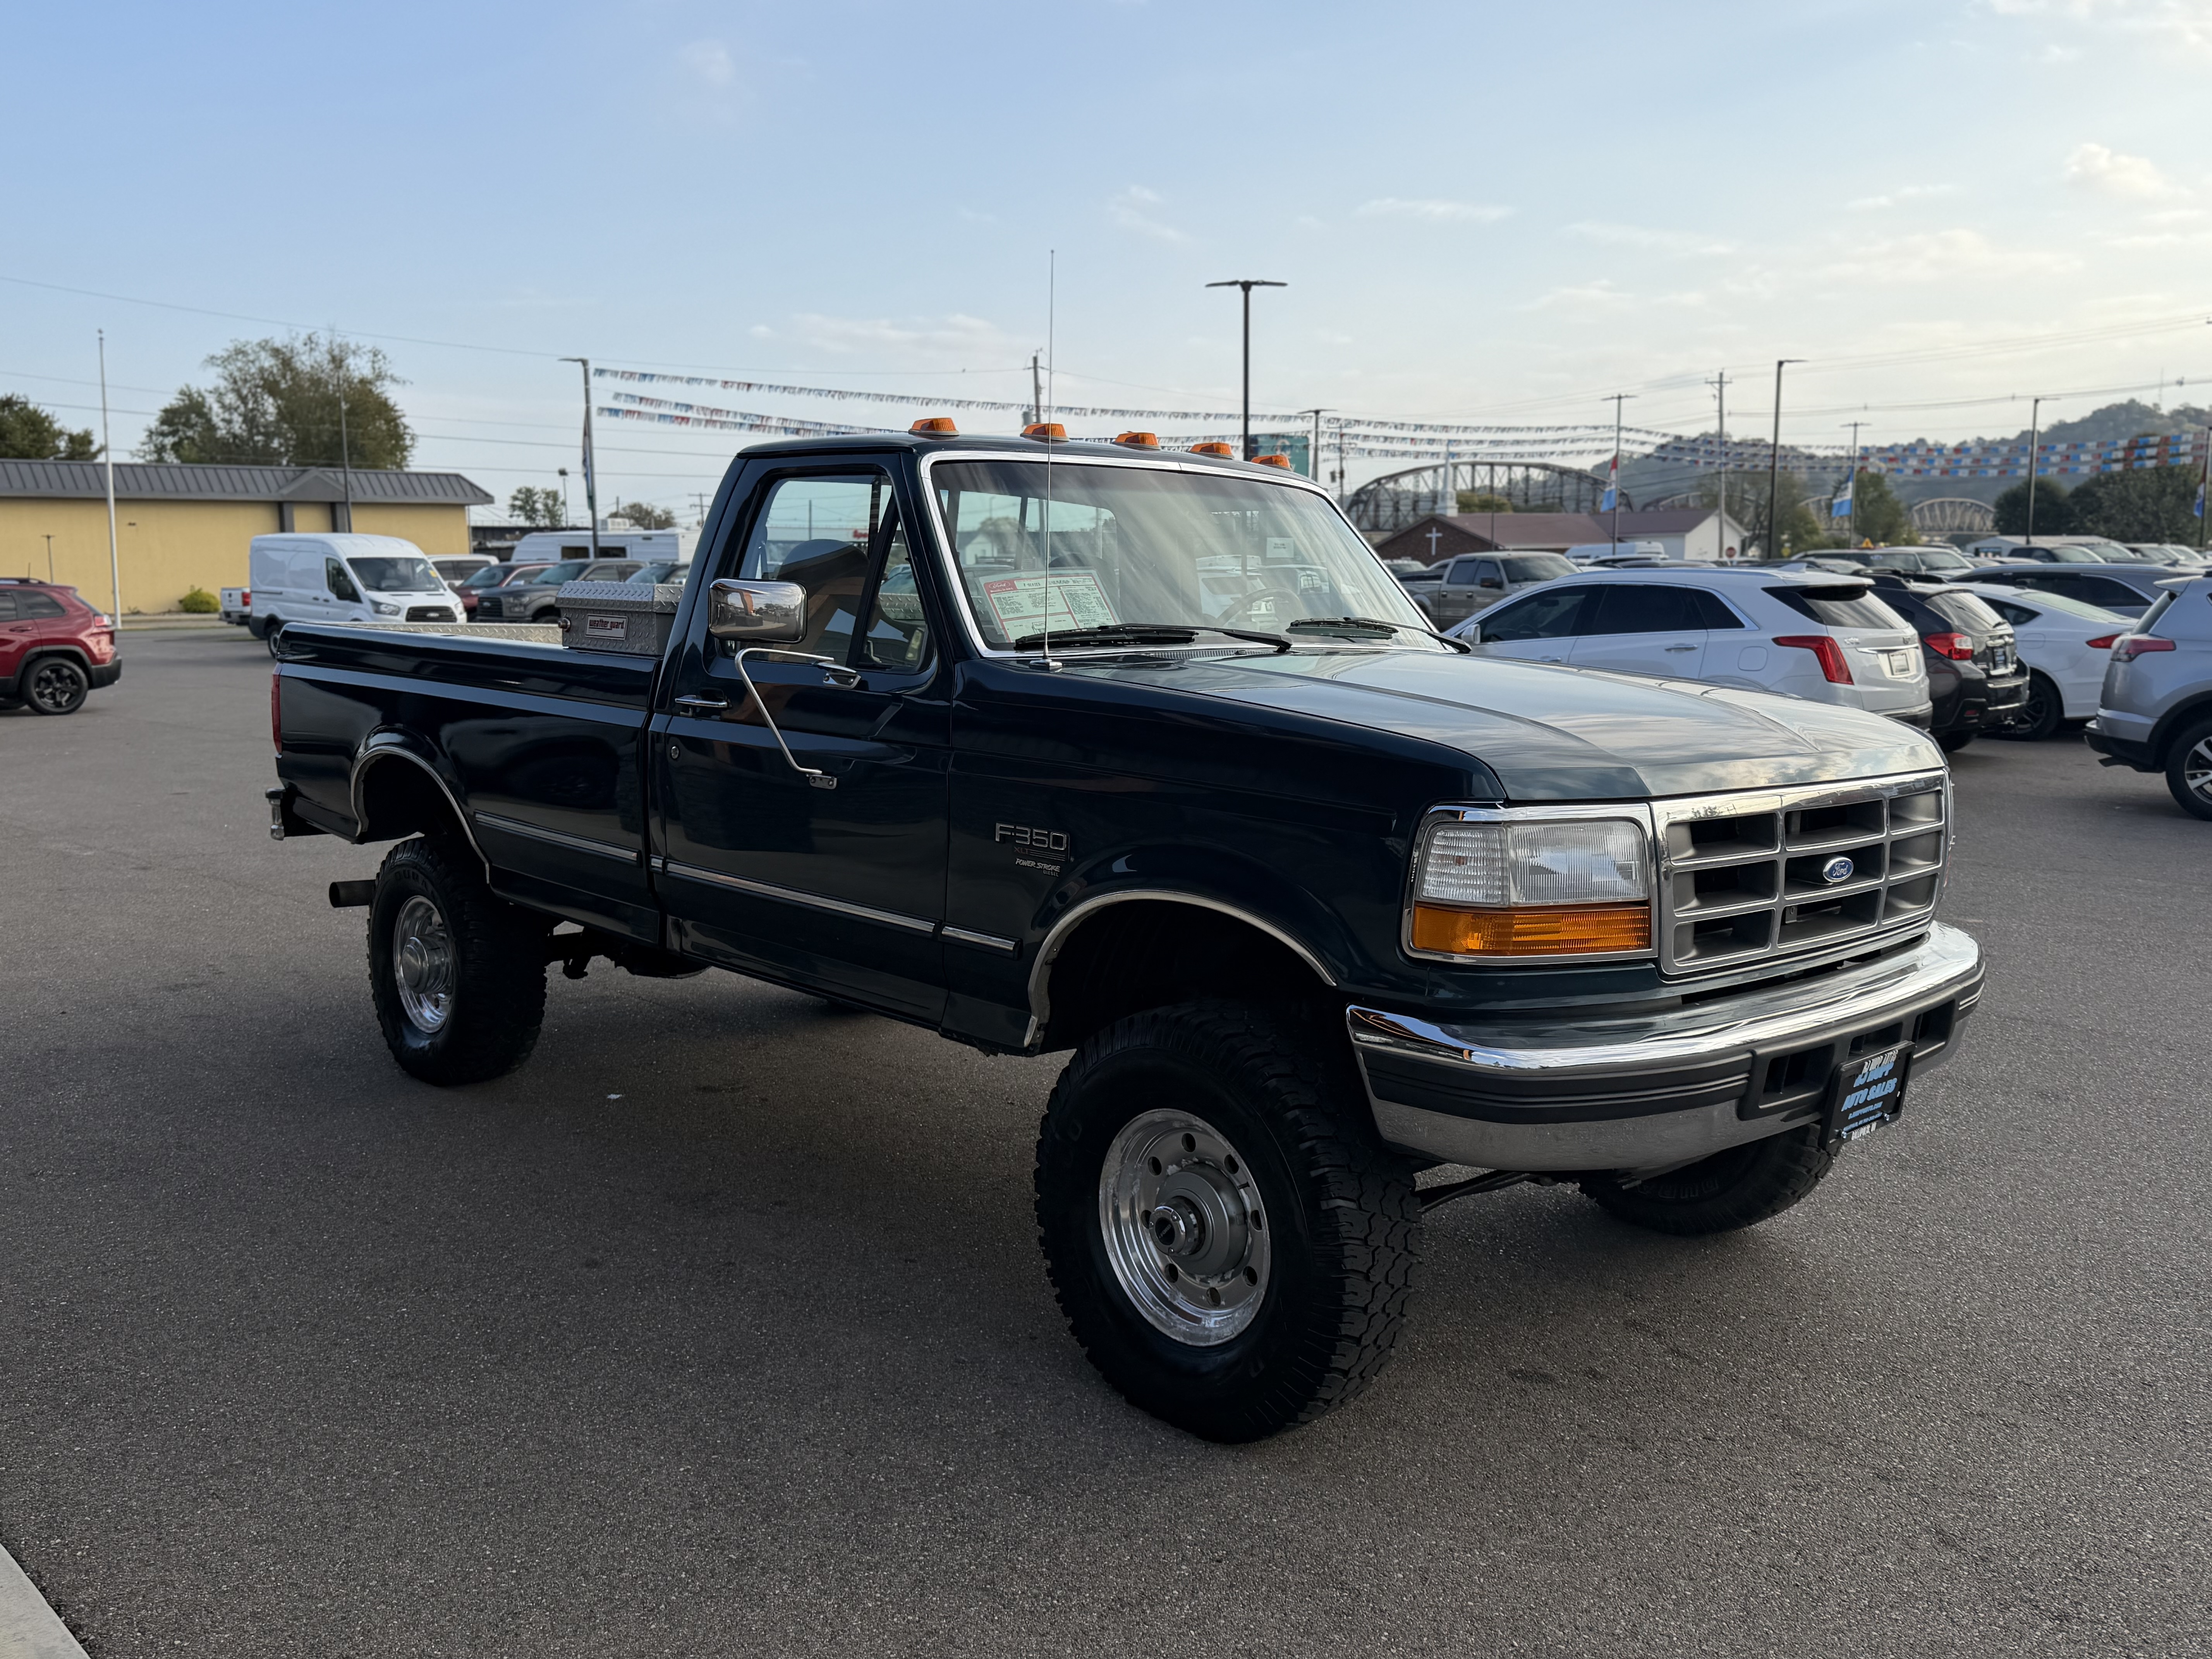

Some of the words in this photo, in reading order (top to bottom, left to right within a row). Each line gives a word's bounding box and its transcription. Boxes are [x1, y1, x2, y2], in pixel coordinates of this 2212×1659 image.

[589, 618, 609, 628] weather
[610, 620, 625, 629] guard
[1013, 846, 1029, 855] XLT
[1015, 857, 1036, 868] POWER
[1036, 862, 1061, 872] STROKE
[1832, 862, 1848, 877] Ford
[1042, 869, 1059, 878] DIESEL
[1841, 1088, 1869, 1112] AUTO
[1867, 1077, 1898, 1101] SALES
